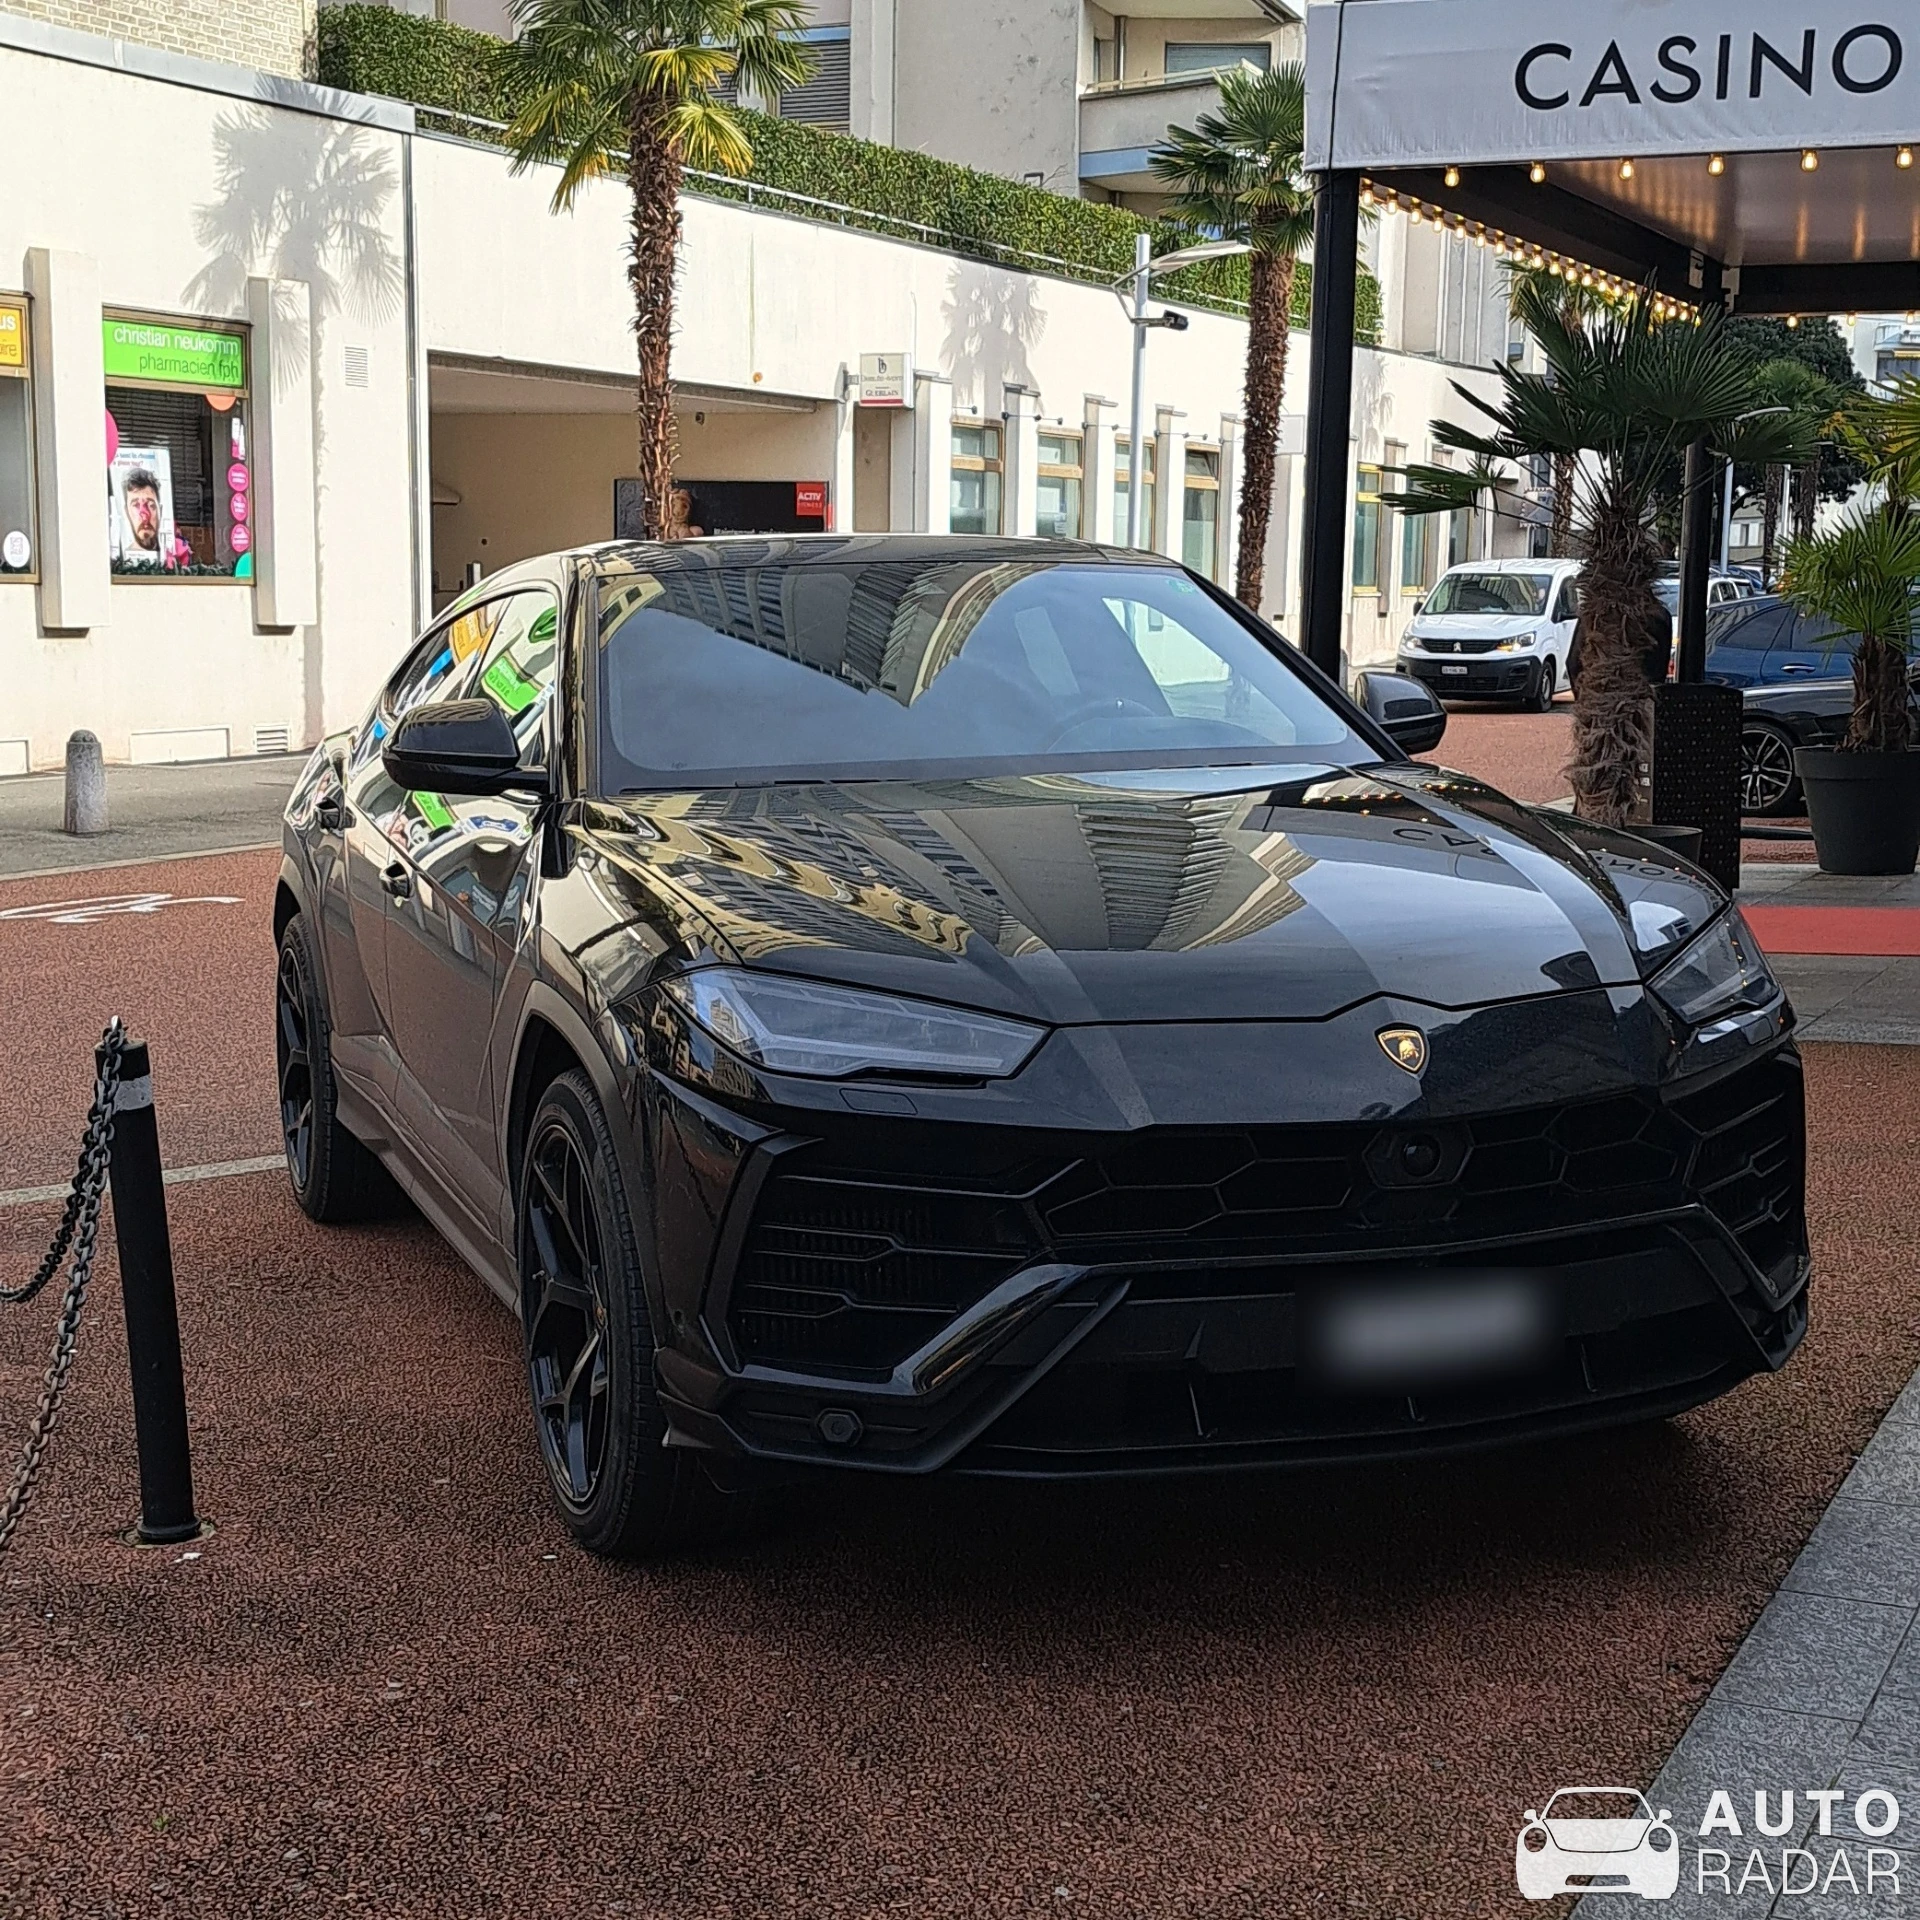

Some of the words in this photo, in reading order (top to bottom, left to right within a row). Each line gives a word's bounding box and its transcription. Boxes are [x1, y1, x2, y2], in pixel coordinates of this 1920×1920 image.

[1514, 23, 1903, 111] CASINO
[113, 325, 171, 348] christian
[174, 334, 239, 356] neukomm
[139, 352, 216, 376] pharmacien
[218, 359, 239, 381] fph
